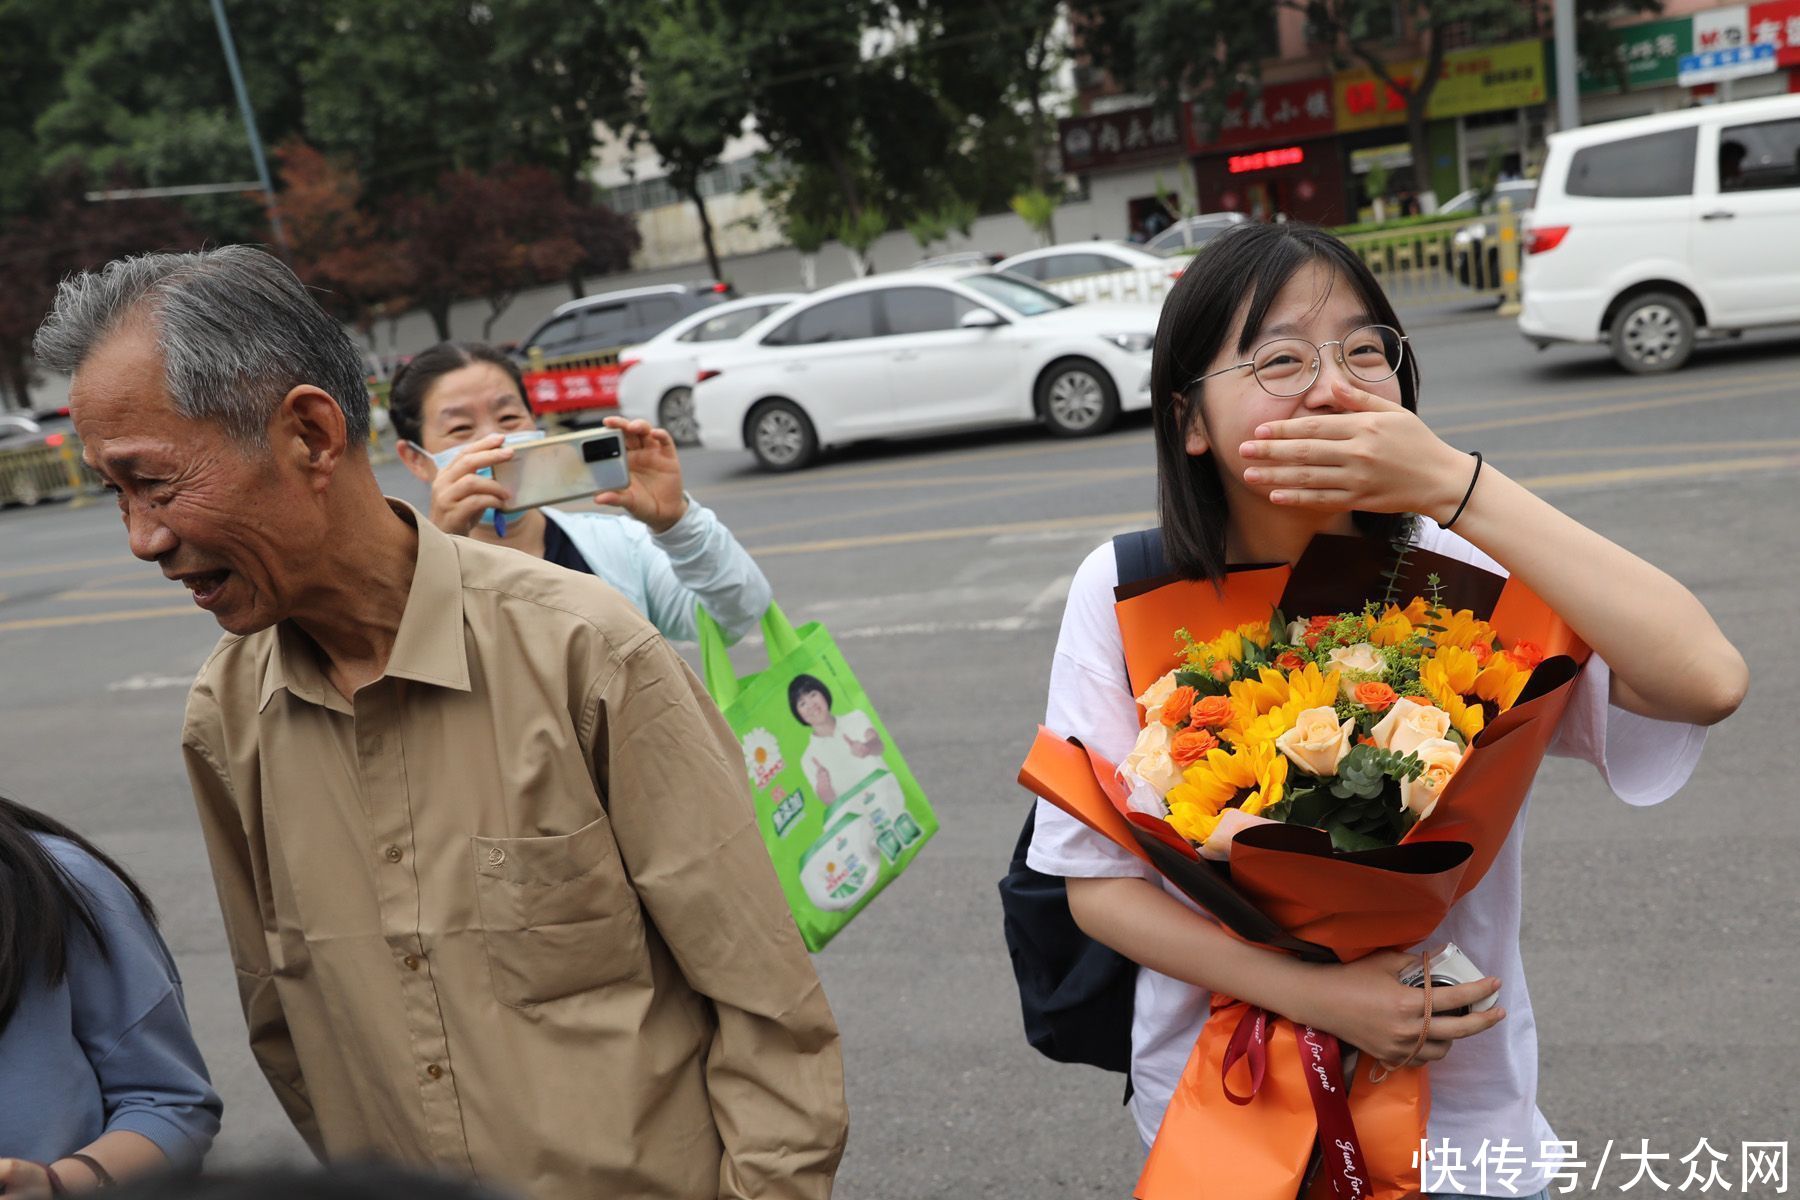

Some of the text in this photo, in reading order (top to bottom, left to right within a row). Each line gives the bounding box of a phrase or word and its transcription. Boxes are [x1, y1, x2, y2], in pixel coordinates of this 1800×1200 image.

[1303, 1035, 1323, 1063] for
[1312, 1062, 1330, 1091] you
[1335, 1139, 1363, 1196] Just for
